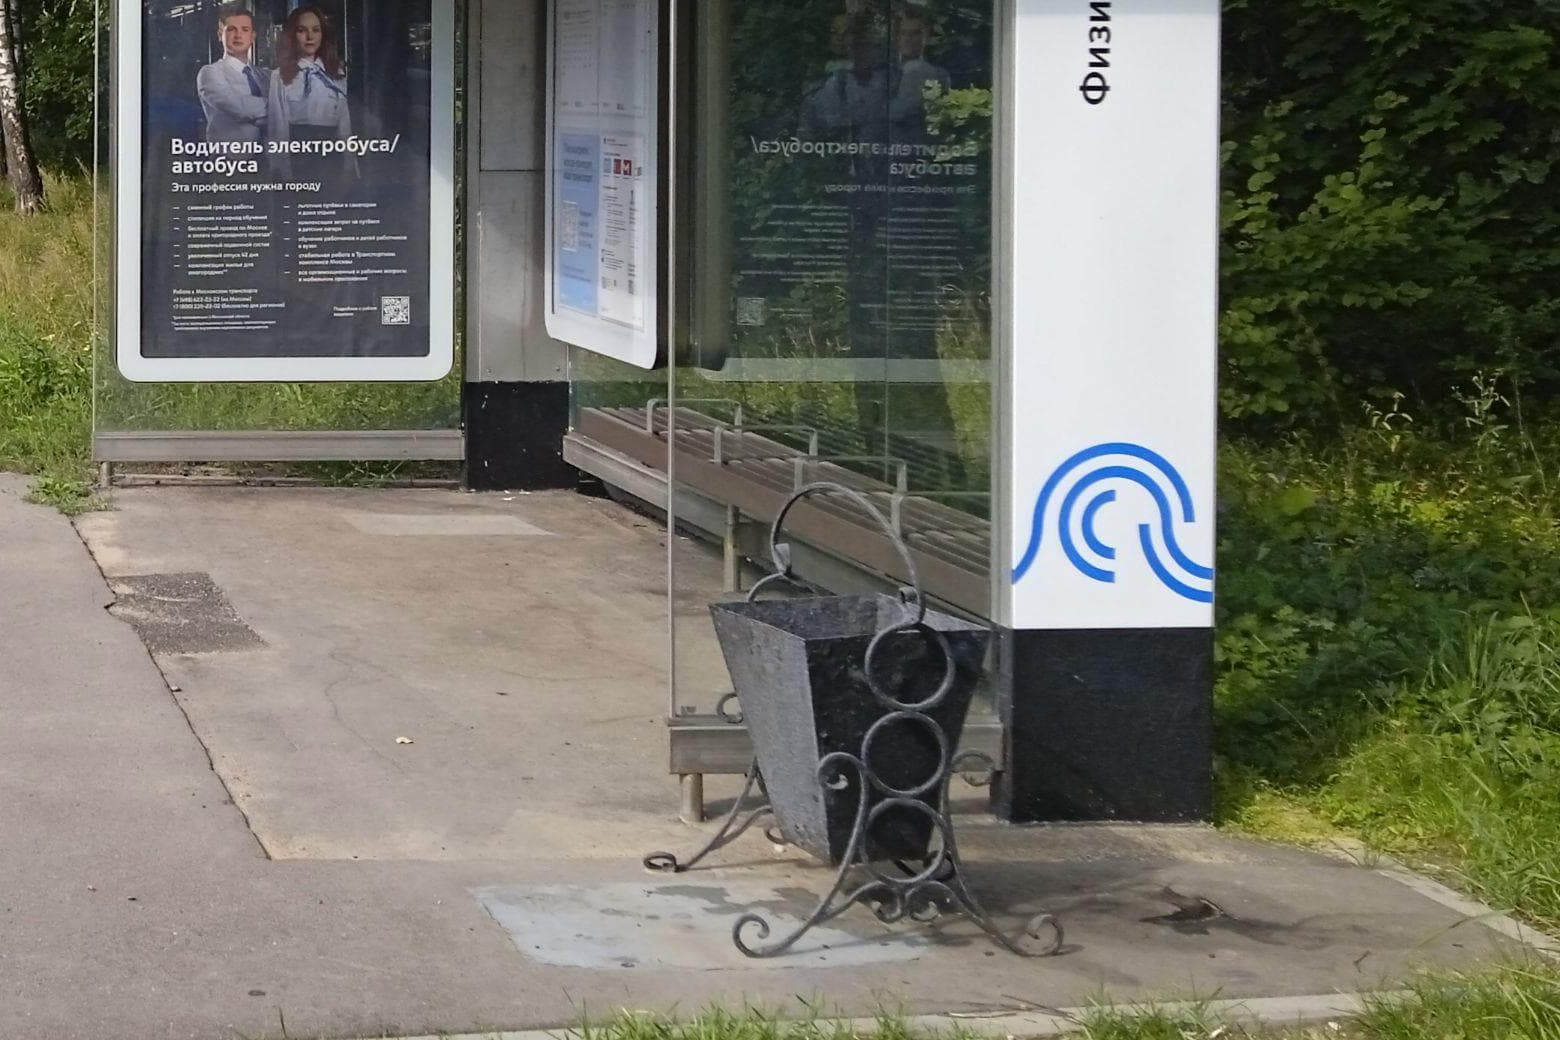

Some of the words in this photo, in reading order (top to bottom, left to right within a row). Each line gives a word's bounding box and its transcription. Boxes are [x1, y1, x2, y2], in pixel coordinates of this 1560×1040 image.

[171, 138, 263, 157] Водитель
[267, 134, 400, 157] электробуса/
[171, 156, 259, 176] автобуса
[171, 182, 190, 192] Эта
[192, 182, 248, 194] профессия
[250, 182, 283, 193] нужна
[285, 181, 321, 193] городу
